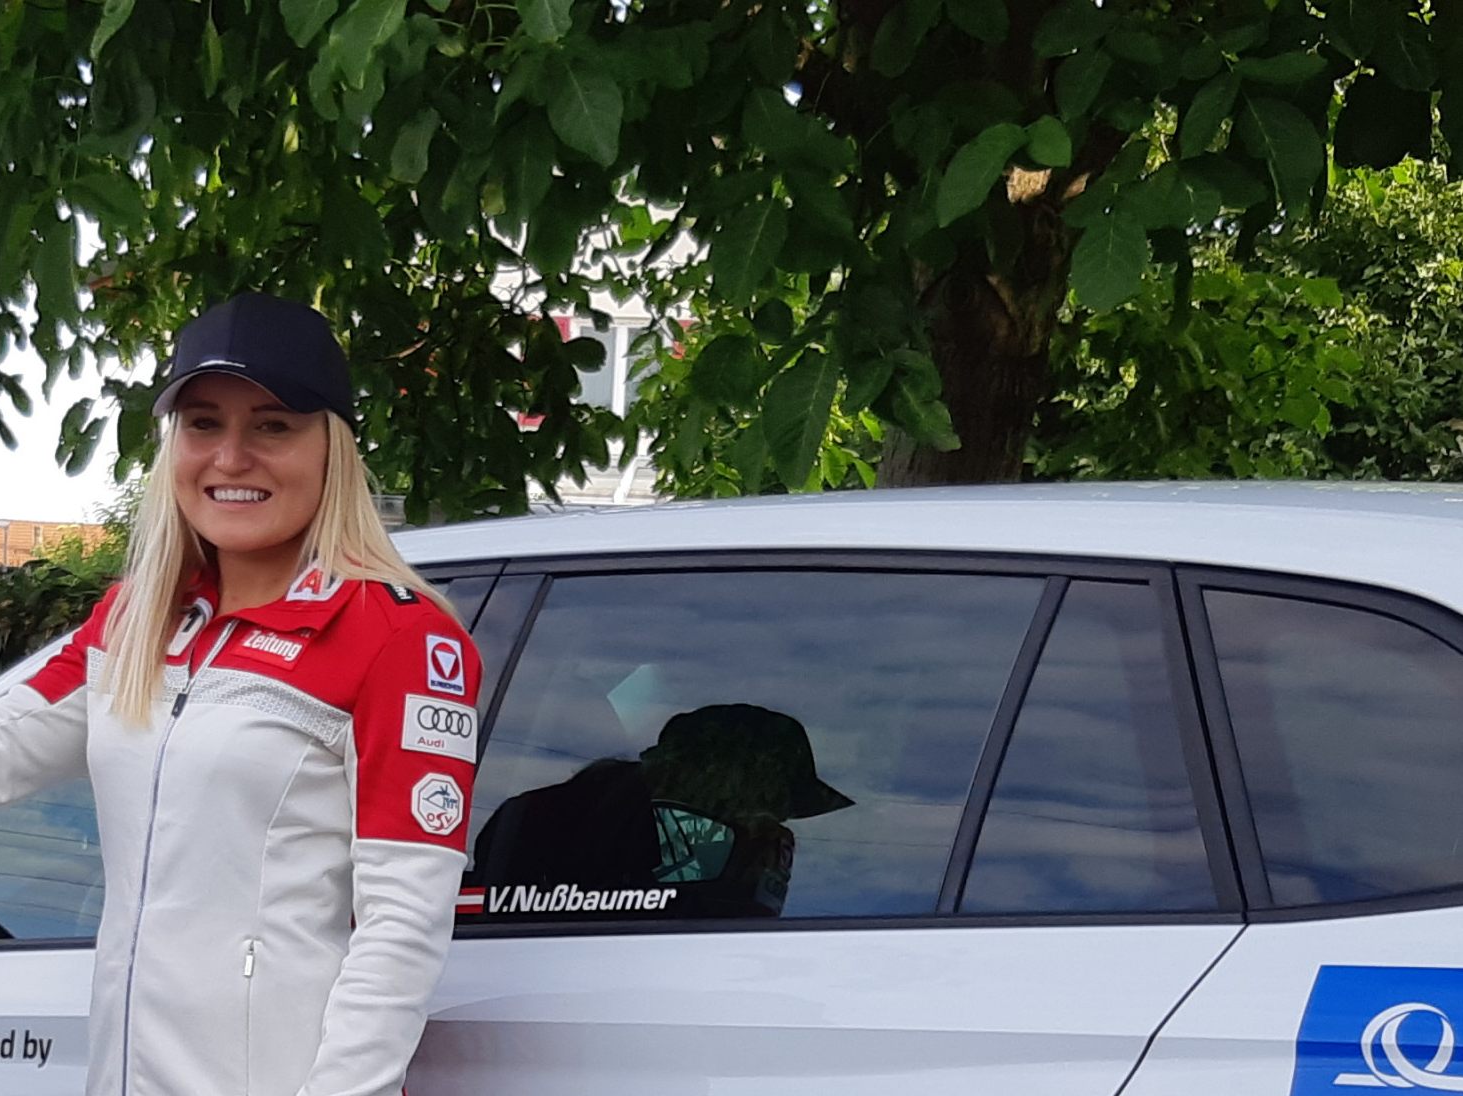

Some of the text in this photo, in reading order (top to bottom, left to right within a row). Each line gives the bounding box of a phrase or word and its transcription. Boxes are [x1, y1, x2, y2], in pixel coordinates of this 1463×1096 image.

[242, 629, 303, 662] Zeitung
[417, 736, 445, 749] Audi
[489, 884, 677, 913] V.Nußbaumer
[22, 1029, 53, 1068] by
